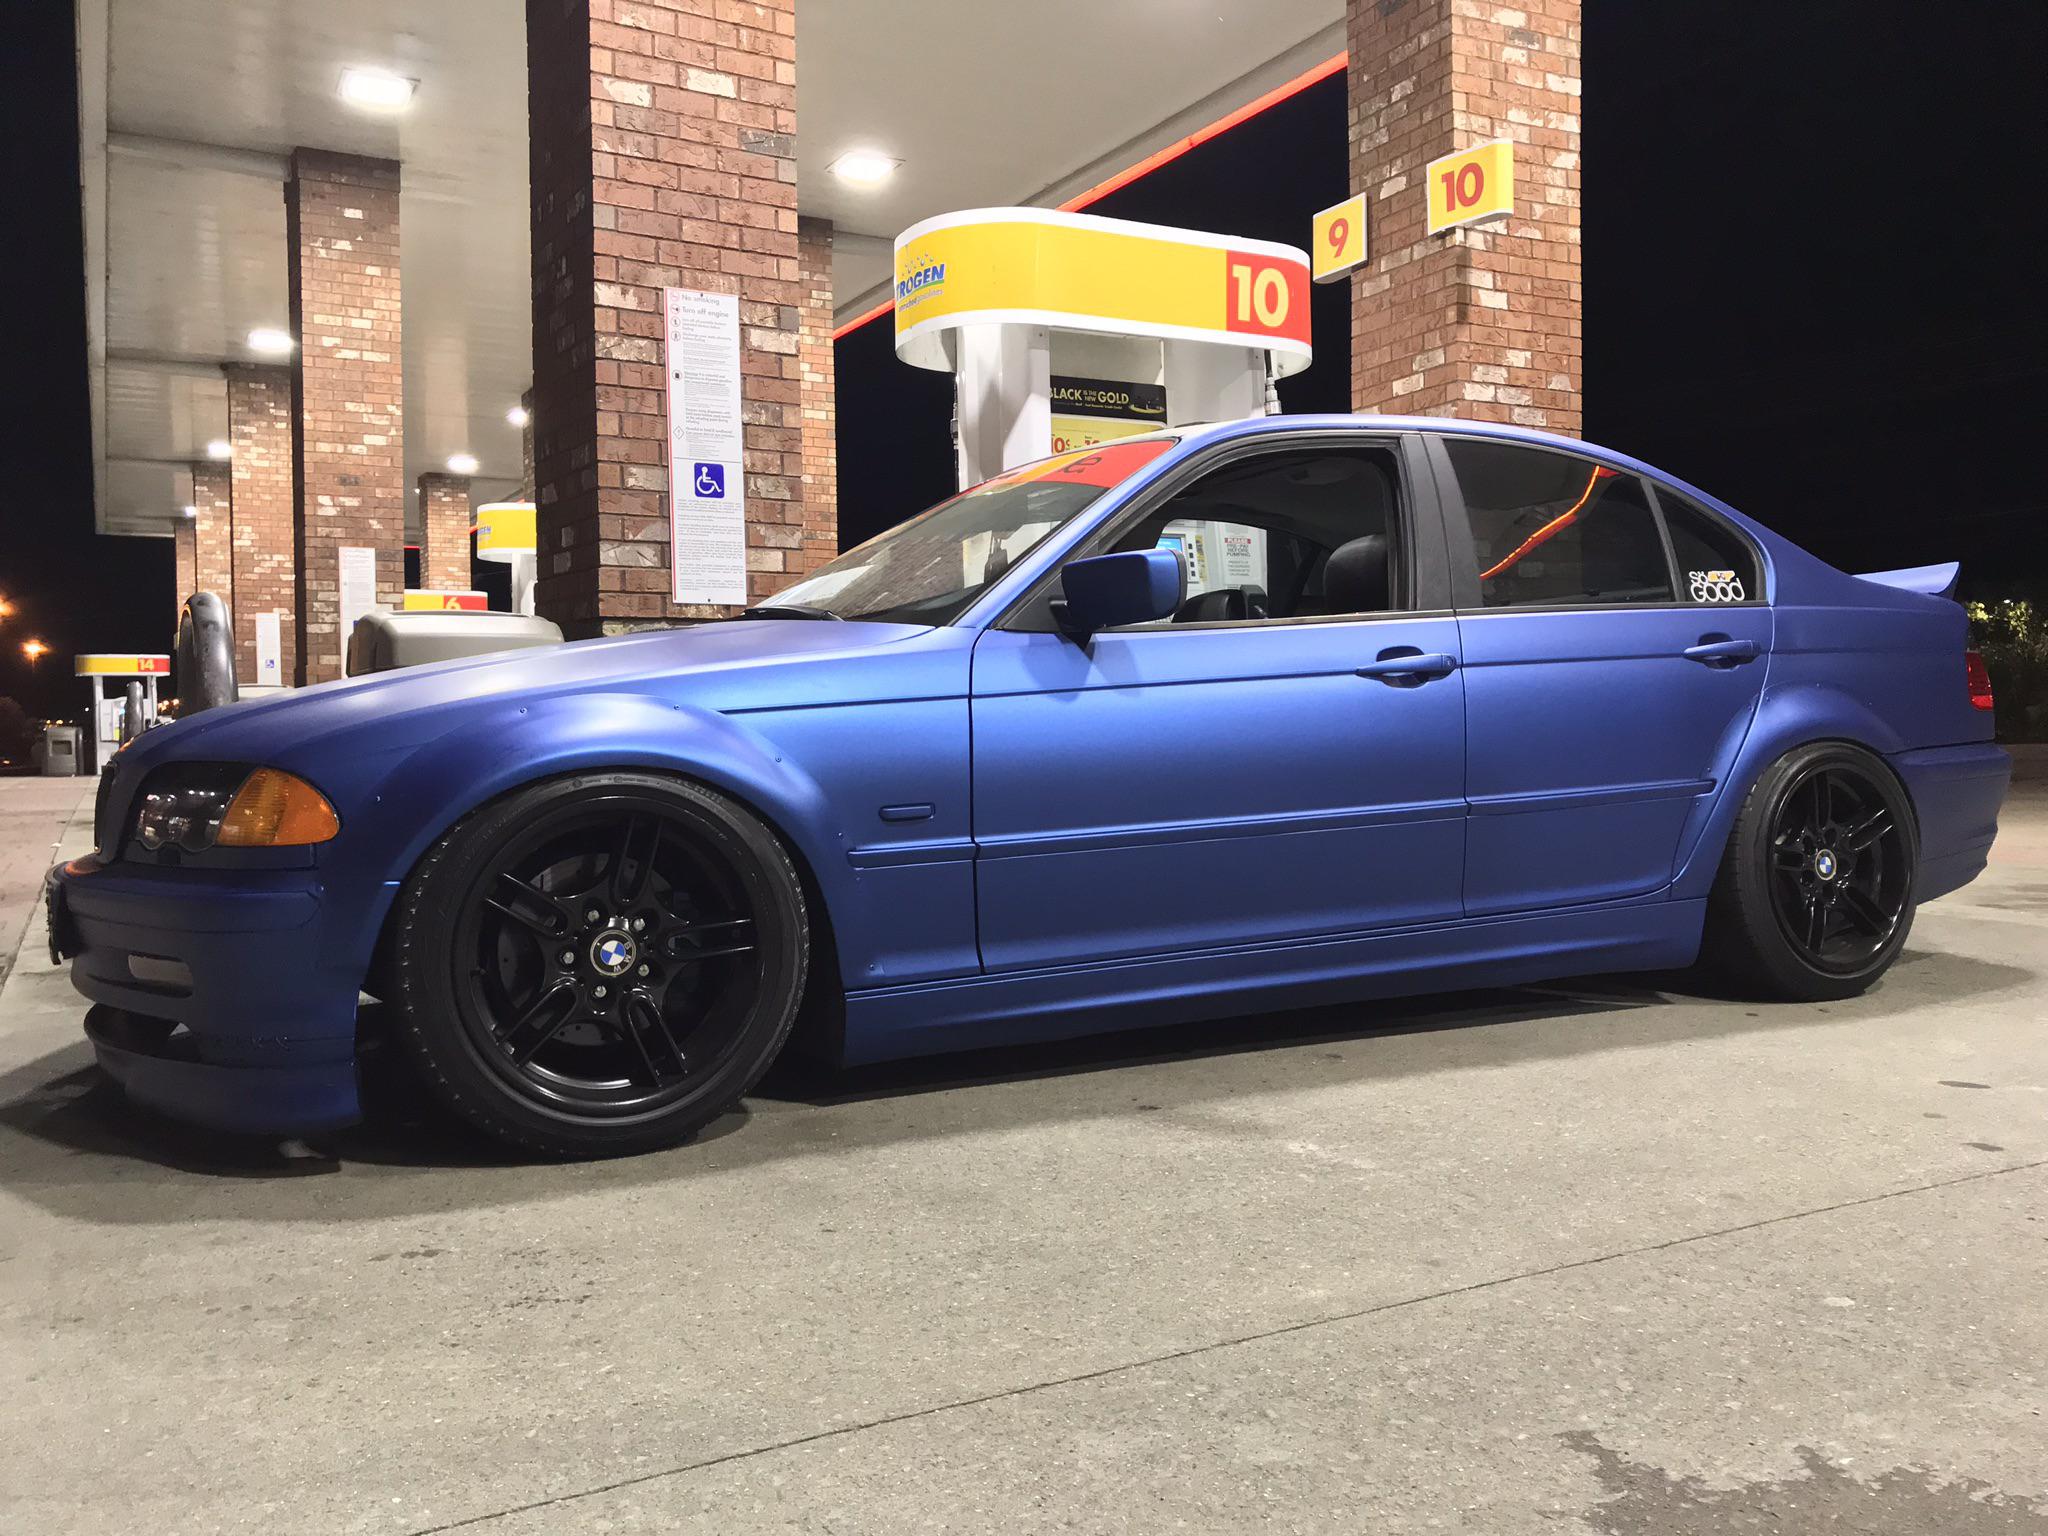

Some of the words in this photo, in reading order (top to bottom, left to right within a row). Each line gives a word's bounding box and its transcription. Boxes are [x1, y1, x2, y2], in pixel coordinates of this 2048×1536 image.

[1441, 162, 1485, 212] 10
[1328, 218, 1349, 258] 9
[694, 295, 720, 306] smoking
[1232, 265, 1290, 328] 10
[697, 307, 707, 315] off
[708, 310, 729, 318] engine
[1097, 391, 1130, 404] GOLD
[445, 597, 462, 610] 6
[140, 659, 154, 670] 14
